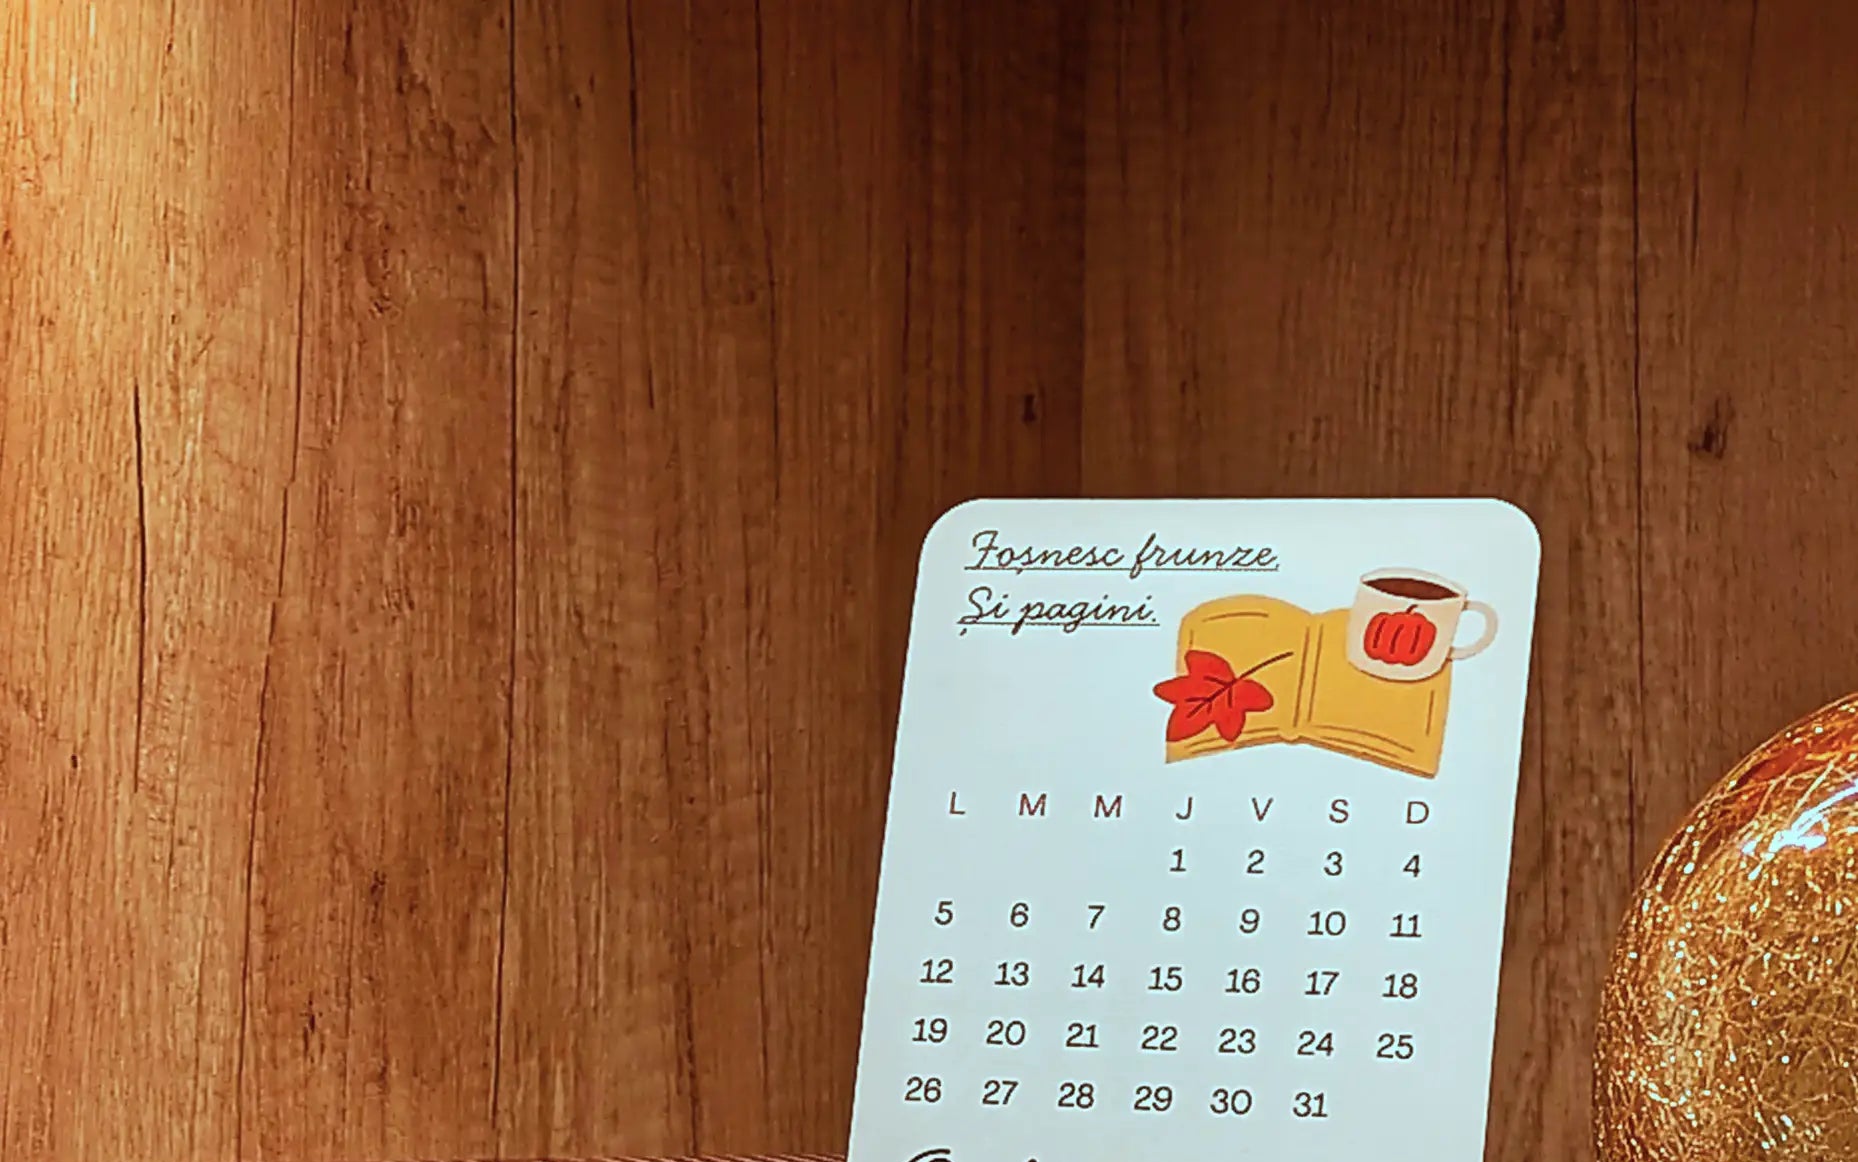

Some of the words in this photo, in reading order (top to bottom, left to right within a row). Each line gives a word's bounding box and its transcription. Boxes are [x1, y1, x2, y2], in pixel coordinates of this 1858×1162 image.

[1010, 594, 1158, 635] pagini.
[949, 791, 966, 816] L
[1018, 792, 1047, 817] M
[1093, 794, 1123, 818] M
[1175, 796, 1193, 821] J
[1251, 797, 1274, 822] V
[1328, 798, 1349, 824] S
[1405, 800, 1430, 825] D
[1169, 848, 1187, 873] 1
[1246, 849, 1265, 875] 2
[1323, 850, 1343, 877] 3
[1402, 853, 1421, 878] 4
[934, 900, 954, 926] 5
[1009, 902, 1030, 928] 6
[1087, 904, 1106, 930] 7
[1162, 906, 1181, 932] 8
[1238, 908, 1261, 935] 9
[1306, 910, 1347, 937] 10
[1389, 913, 1423, 938] 11
[919, 958, 954, 984] 12
[994, 961, 1030, 987] 13
[1071, 963, 1105, 989] 14
[1147, 966, 1183, 992] 15
[1224, 968, 1261, 994] 16
[1304, 970, 1340, 996] 17
[1381, 972, 1418, 1000] 18
[911, 1017, 948, 1044] 19
[985, 1019, 1026, 1046] 20
[1065, 1022, 1100, 1049] 21
[1141, 1024, 1178, 1052] 22
[1218, 1027, 1256, 1055] 23
[1296, 1030, 1335, 1057] 24
[1375, 1032, 1414, 1060] 25
[904, 1075, 942, 1104] 26
[982, 1079, 1019, 1106] 27
[1057, 1082, 1095, 1110] 28
[1133, 1085, 1173, 1112] 29
[1209, 1088, 1253, 1116] 30
[1292, 1091, 1329, 1118] 31
